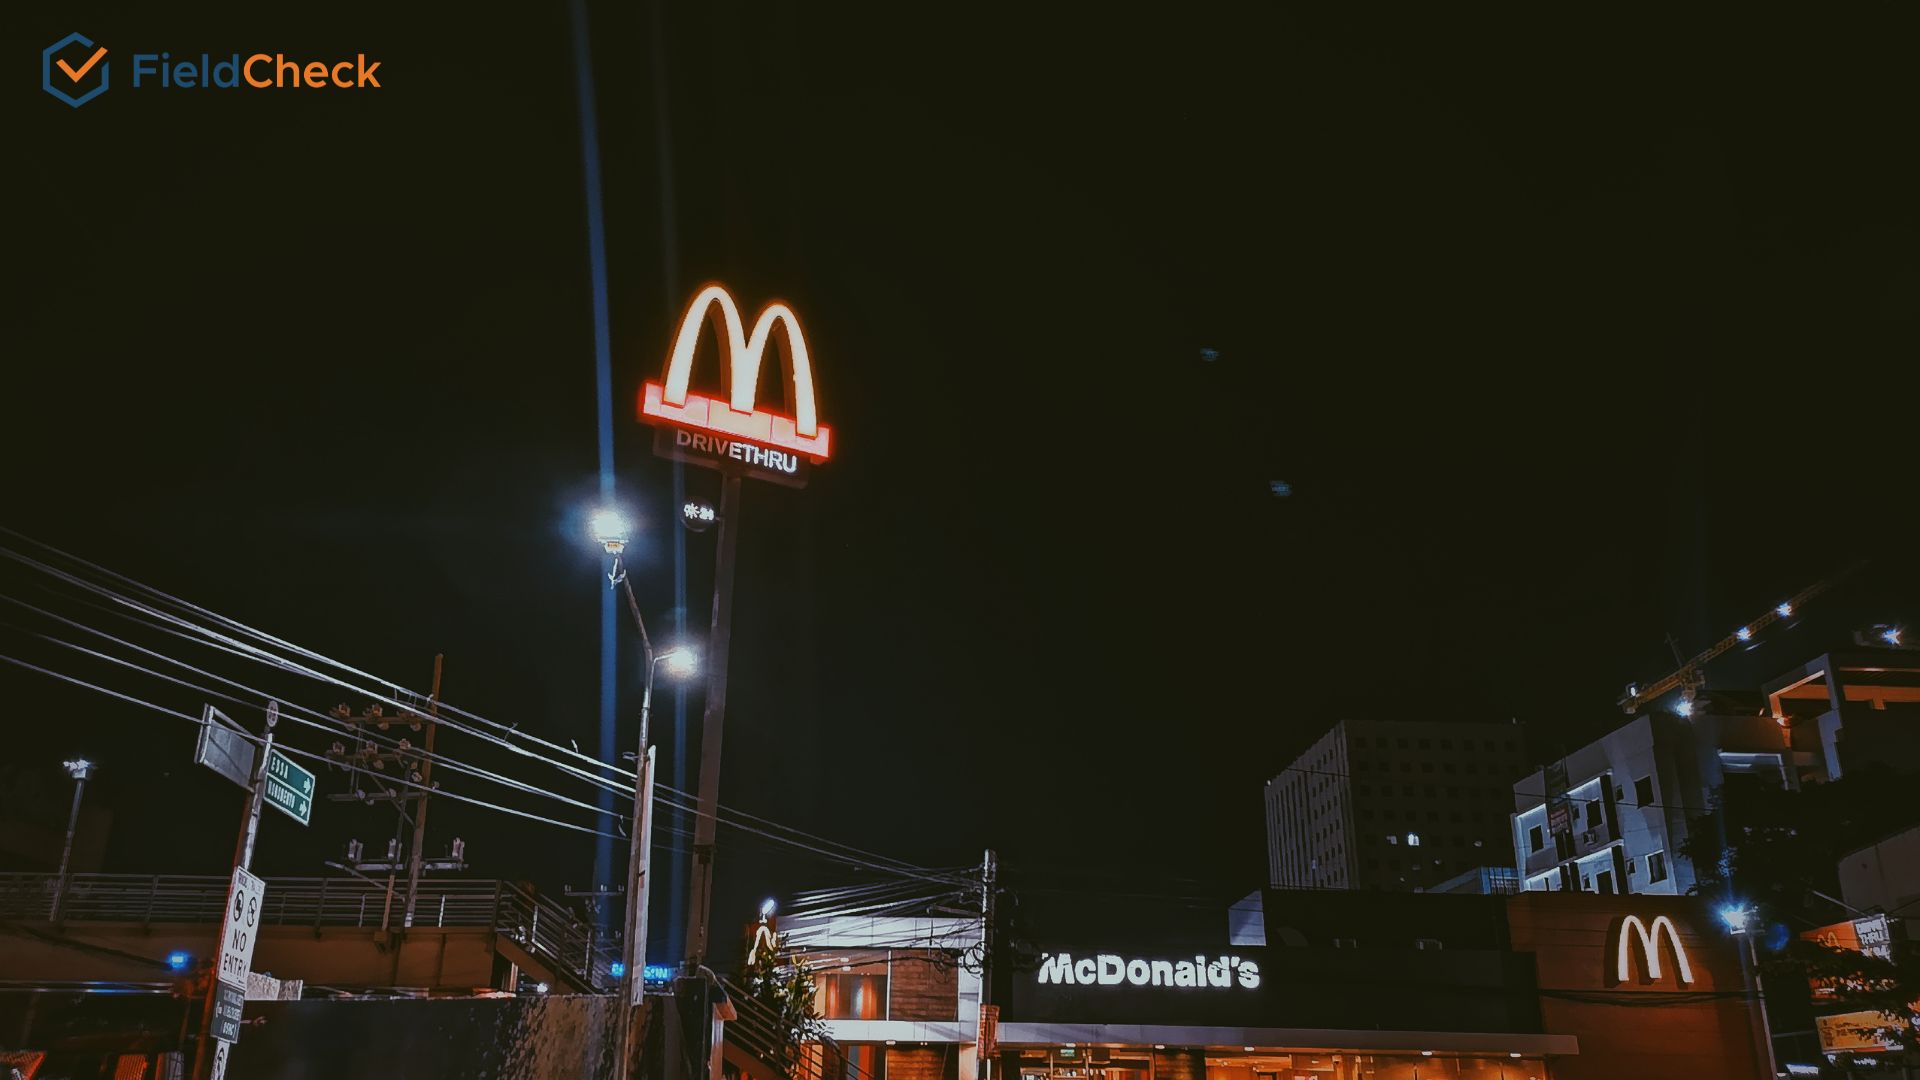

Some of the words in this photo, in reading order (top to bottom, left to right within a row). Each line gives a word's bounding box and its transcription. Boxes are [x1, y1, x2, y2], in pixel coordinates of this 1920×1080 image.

[232, 928, 247, 953] NO
[223, 952, 247, 979] ENTRY
[1038, 953, 1261, 989] McDonald's
